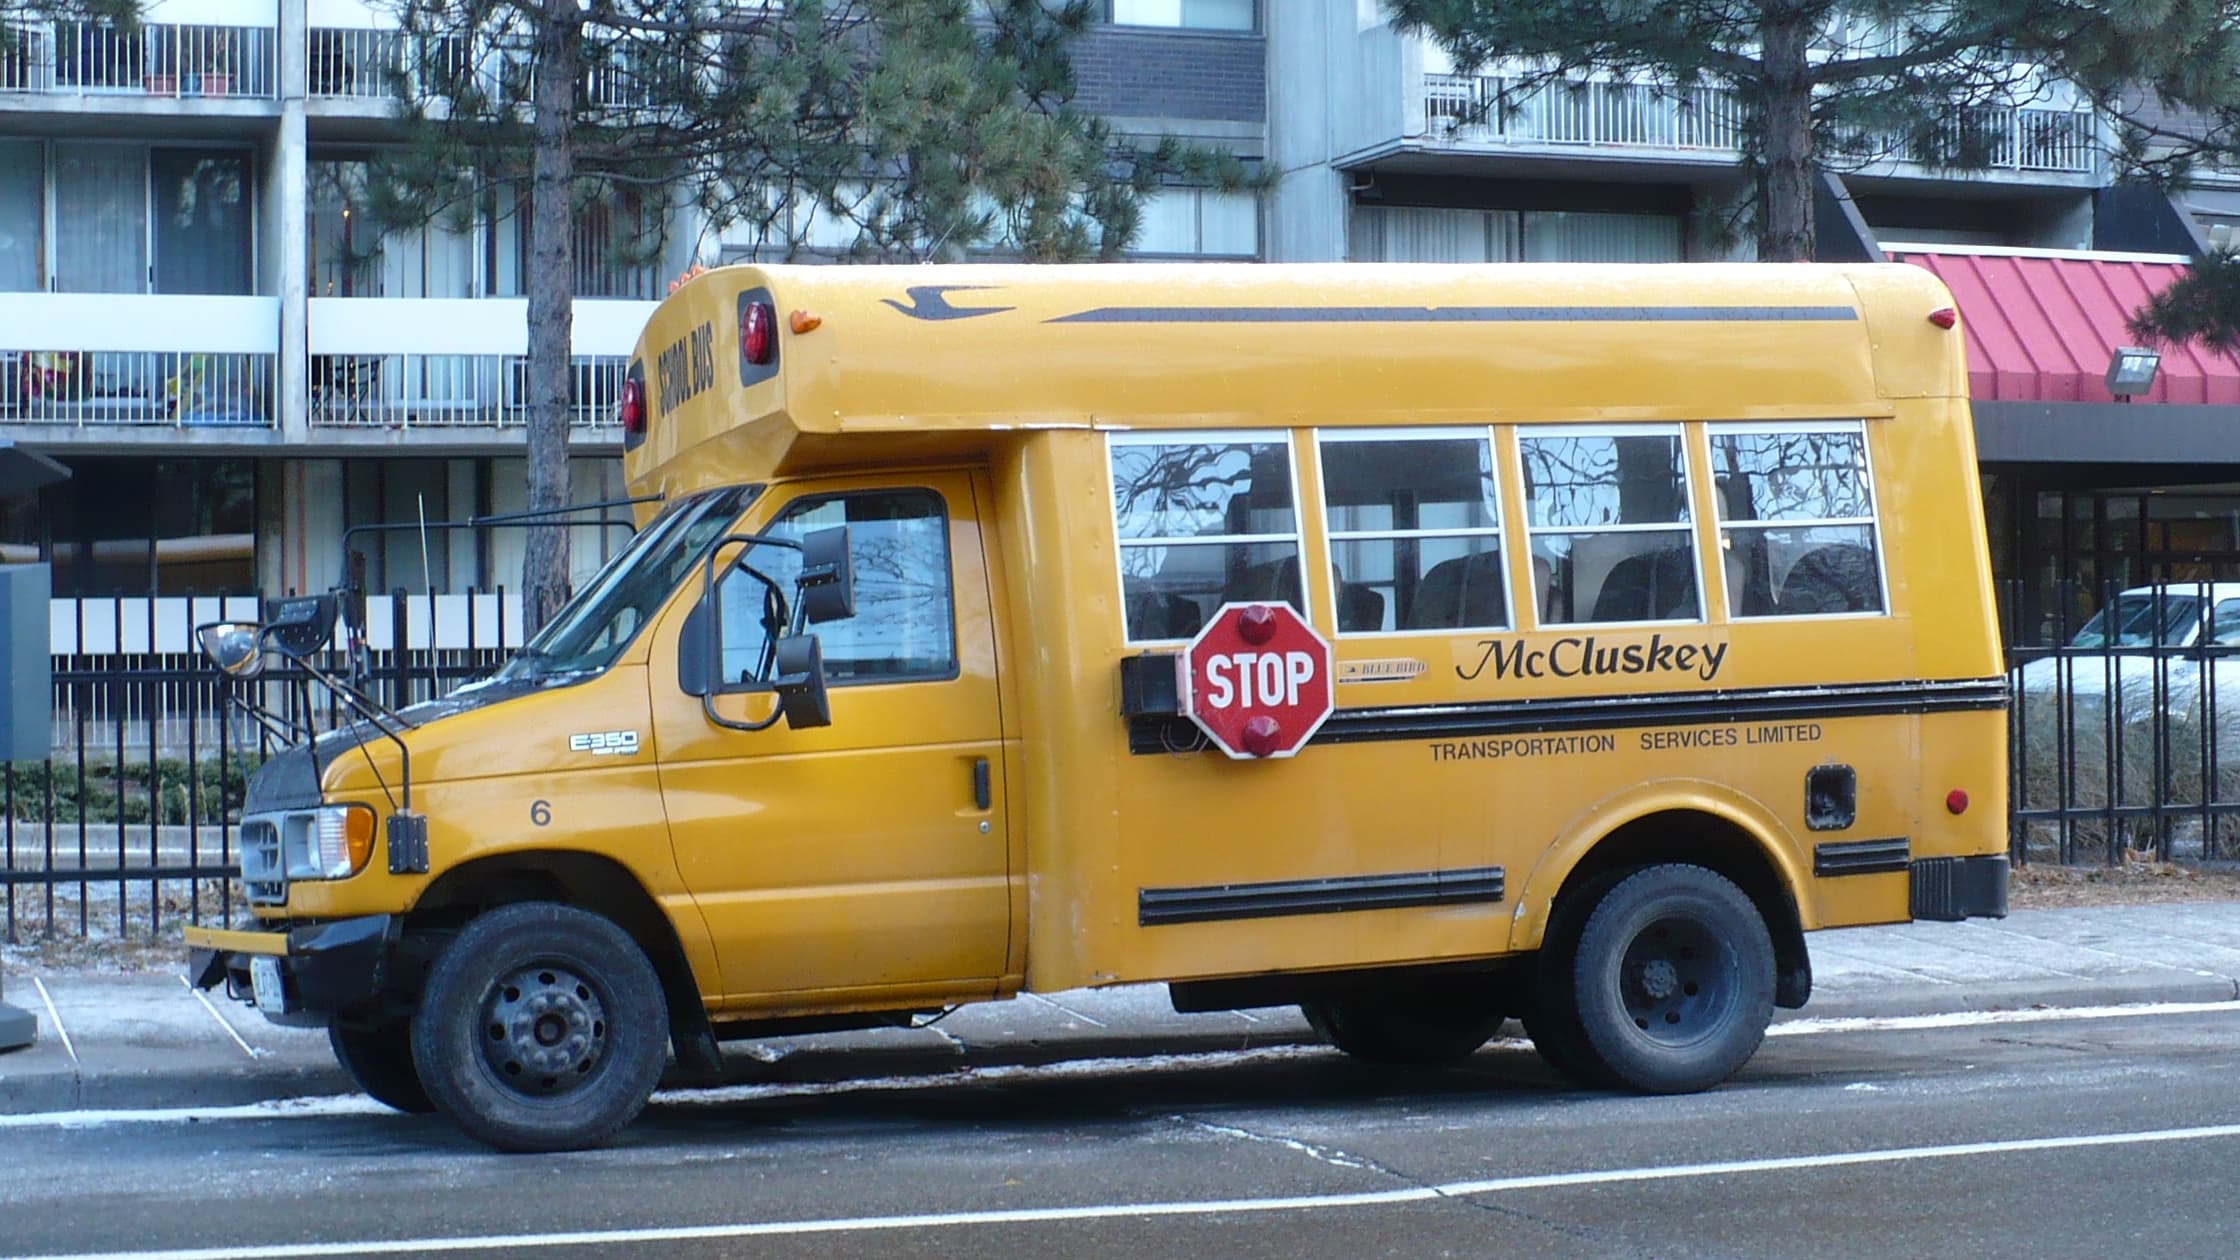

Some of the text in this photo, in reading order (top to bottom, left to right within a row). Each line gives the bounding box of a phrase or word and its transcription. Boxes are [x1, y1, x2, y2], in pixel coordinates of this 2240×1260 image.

[658, 320, 714, 418] SCHOOL BUS
[1362, 661, 1426, 675] BLUE BIRD
[1456, 634, 1728, 681] McCluskey
[1206, 651, 1315, 709] STOP
[1430, 724, 1822, 761] TRANSPORTATION SERVICES LIMITED
[530, 799, 552, 827] 6
